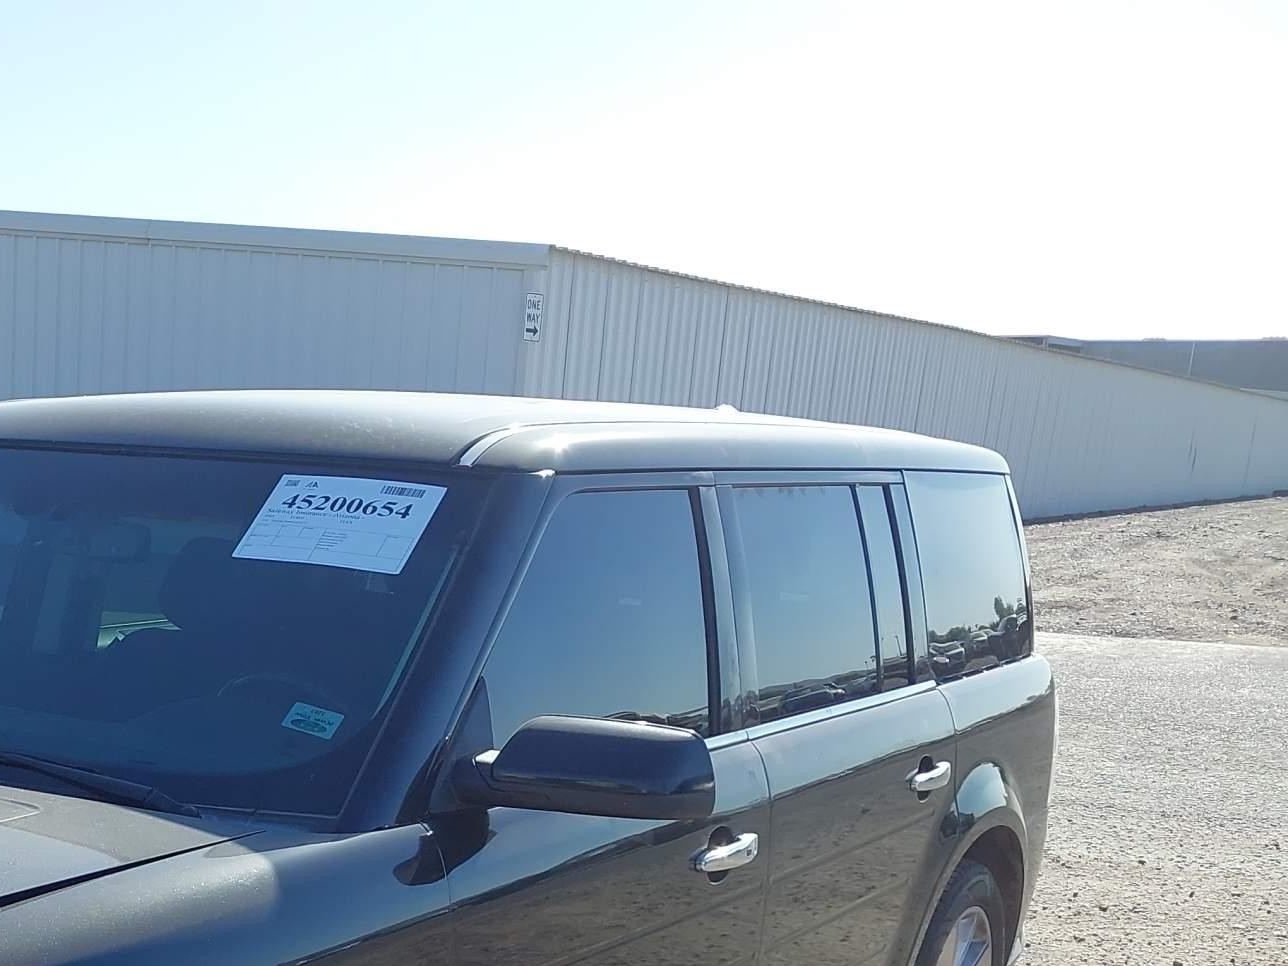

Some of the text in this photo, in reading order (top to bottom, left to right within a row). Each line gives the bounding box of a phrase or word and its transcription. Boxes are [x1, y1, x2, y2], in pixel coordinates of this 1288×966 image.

[527, 299, 541, 310] ONE
[526, 312, 540, 324] WAY
[281, 493, 415, 519] 45200654
